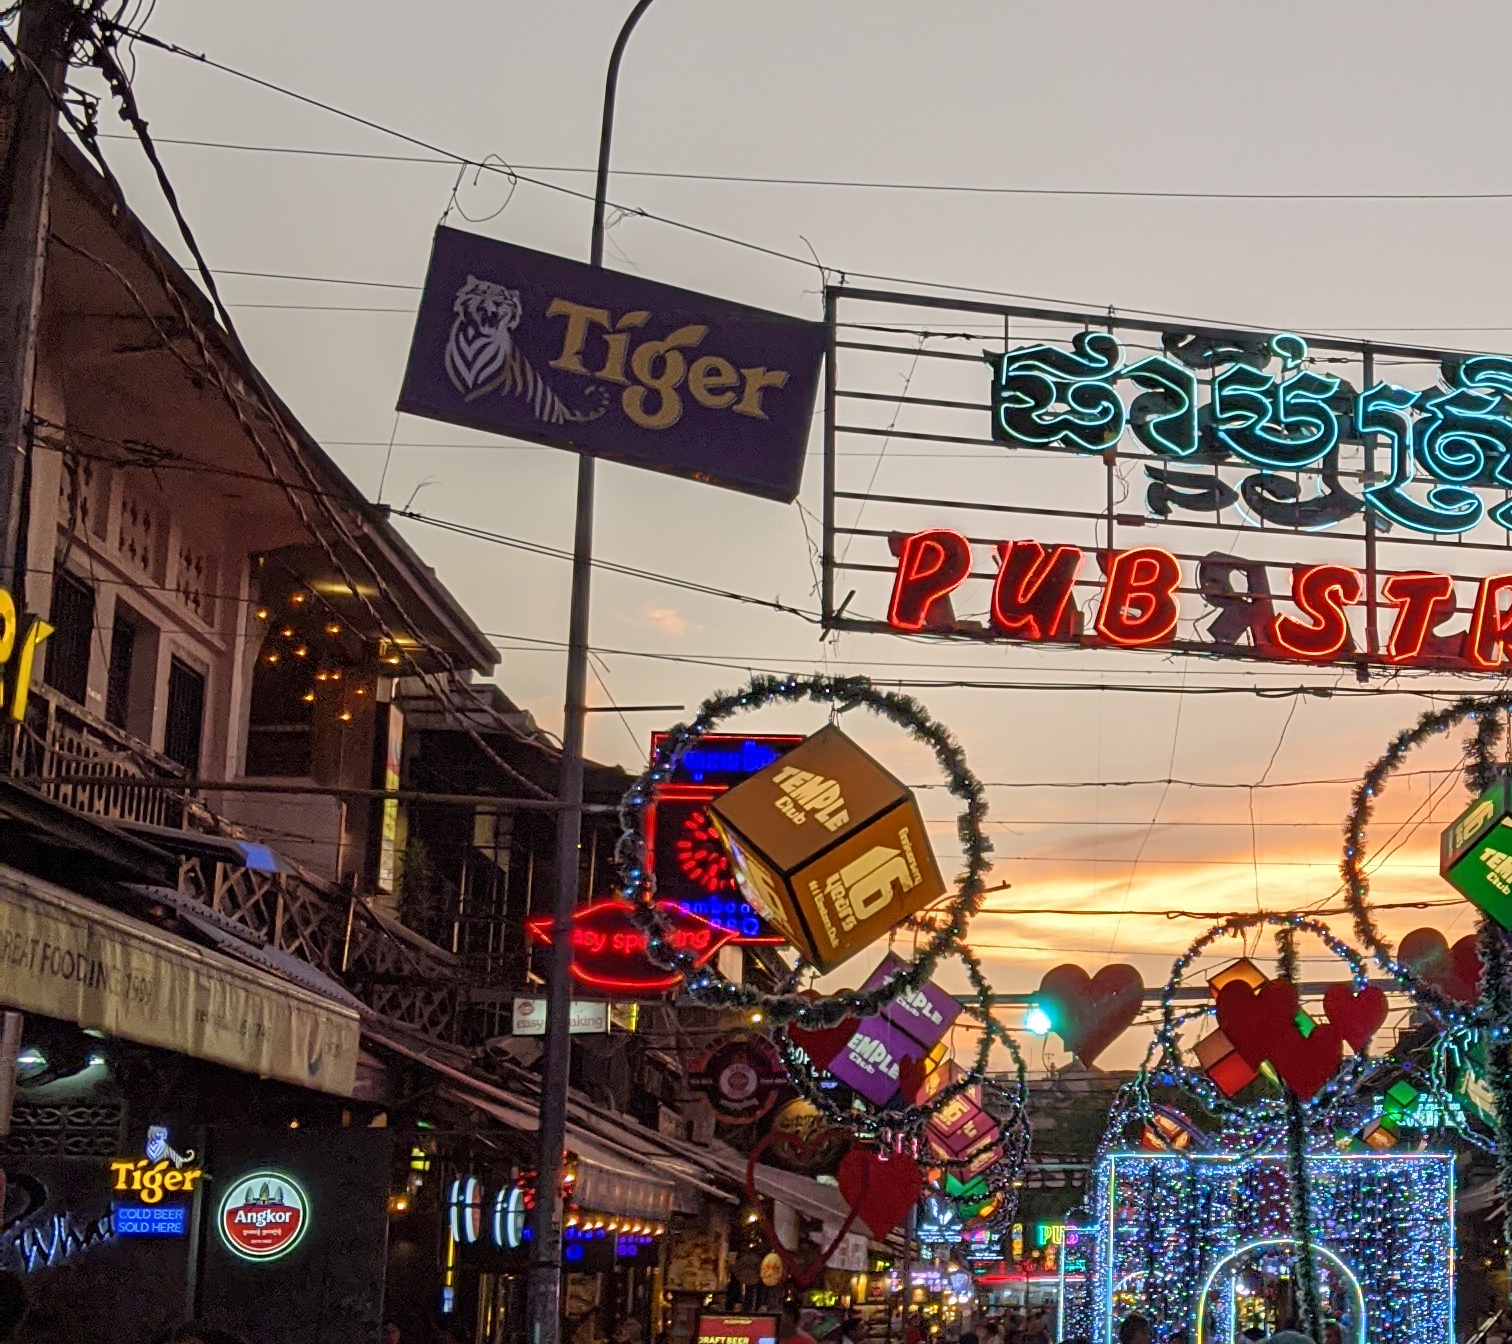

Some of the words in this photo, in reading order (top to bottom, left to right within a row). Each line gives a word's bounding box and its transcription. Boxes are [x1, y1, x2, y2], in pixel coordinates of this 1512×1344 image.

[546, 297, 790, 429] Tiger
[887, 527, 1183, 645] PUB
[773, 765, 850, 833] TEMPLE
[774, 795, 807, 826] Club
[839, 845, 915, 921] 16
[1486, 871, 1512, 896] Club
[573, 928, 607, 953] asy
[110, 1159, 203, 1203] Tiger
[118, 1208, 150, 1221] COLD
[153, 1208, 183, 1221] BEER
[118, 1221, 149, 1234] SOLD
[152, 1221, 182, 1234] HERE
[233, 1208, 293, 1228] Angkor
